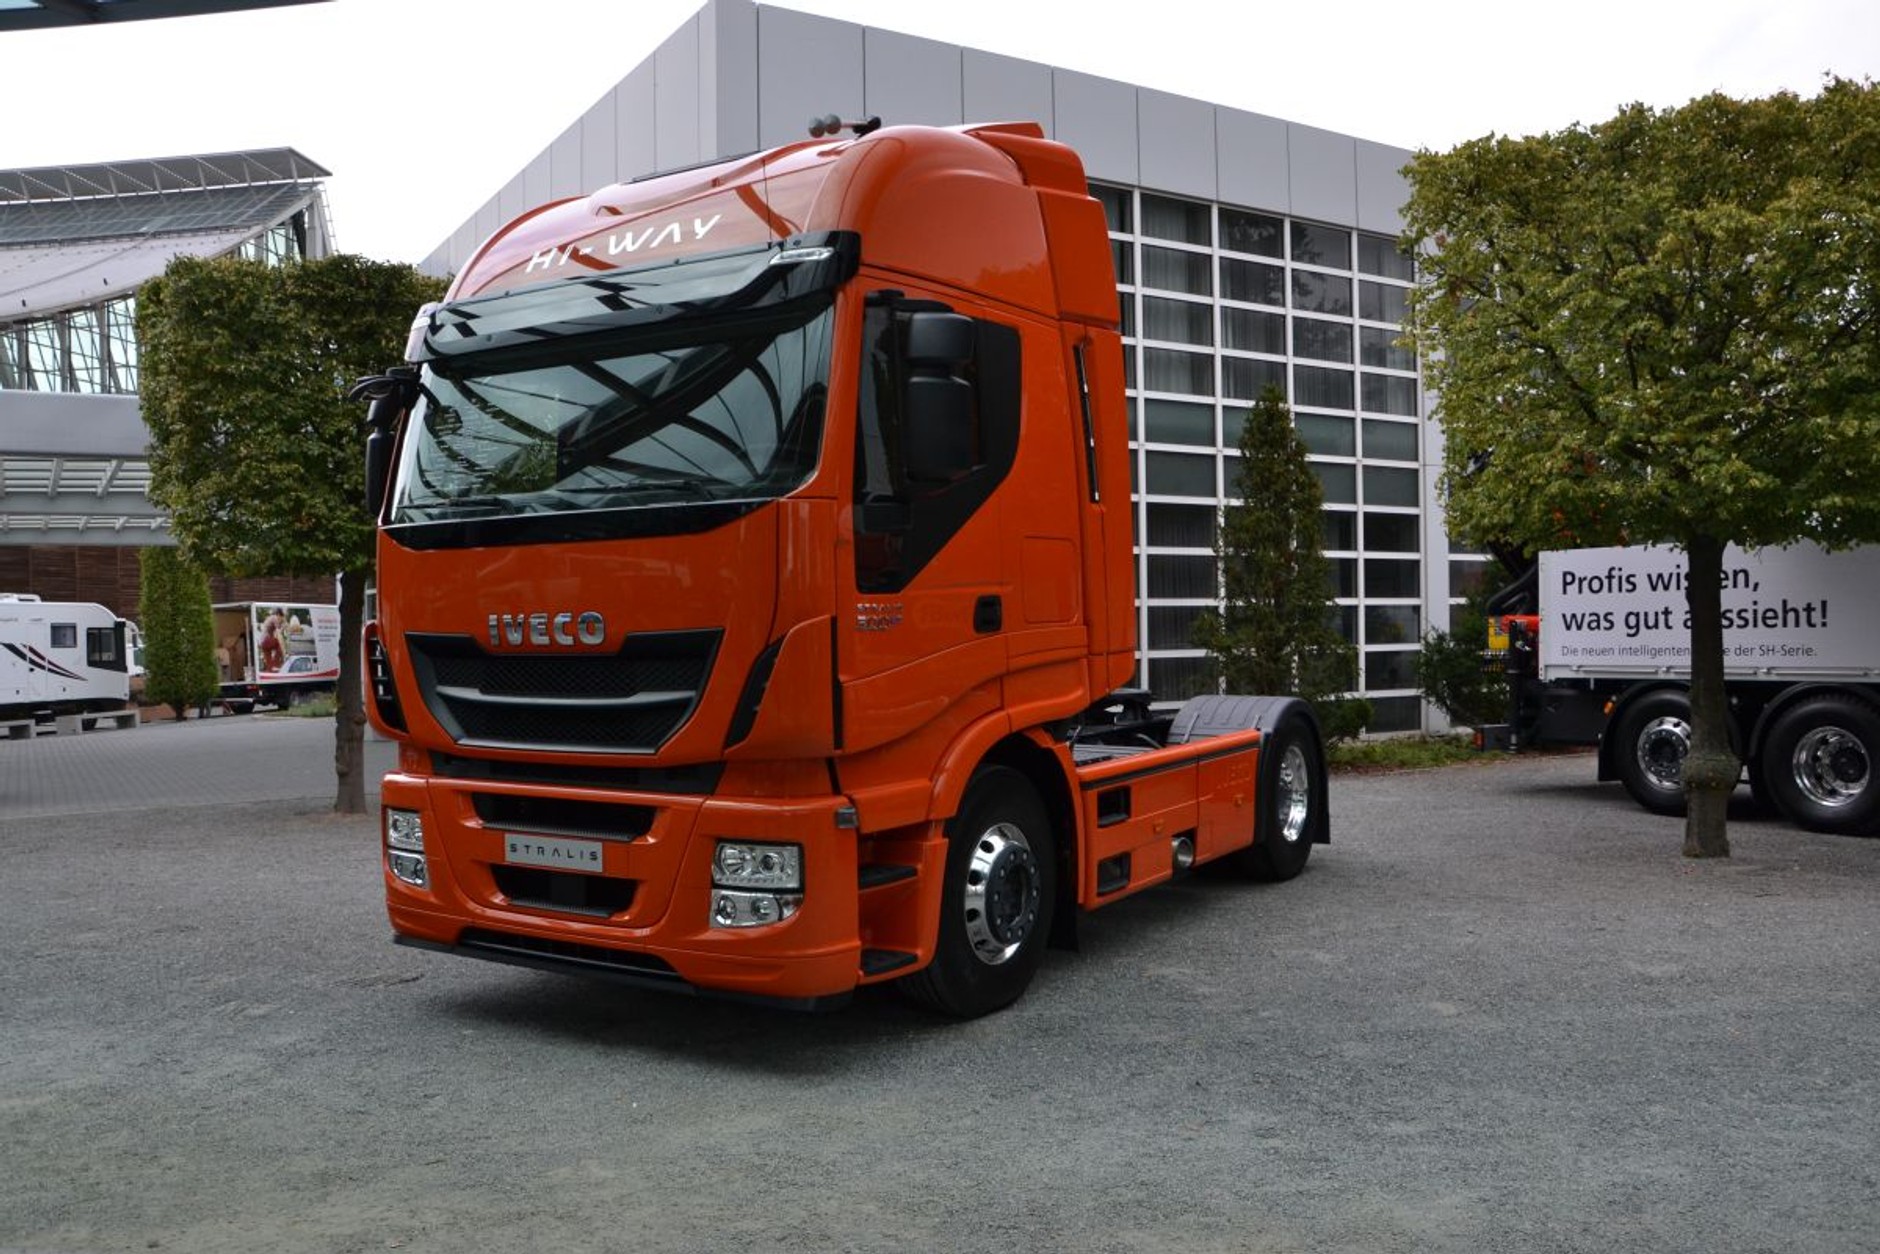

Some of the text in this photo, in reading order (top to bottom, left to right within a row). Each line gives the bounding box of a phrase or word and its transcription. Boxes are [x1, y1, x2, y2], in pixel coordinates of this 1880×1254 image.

[1562, 564, 1760, 595] Profis wien,
[488, 610, 606, 646] IVECO
[1561, 598, 1828, 638] was gut assieht!
[1561, 645, 1579, 657] Die
[1581, 646, 1615, 657] neuen
[1618, 644, 1691, 660] intelligenten
[1734, 644, 1756, 657] der
[509, 843, 599, 861] STRALIS
